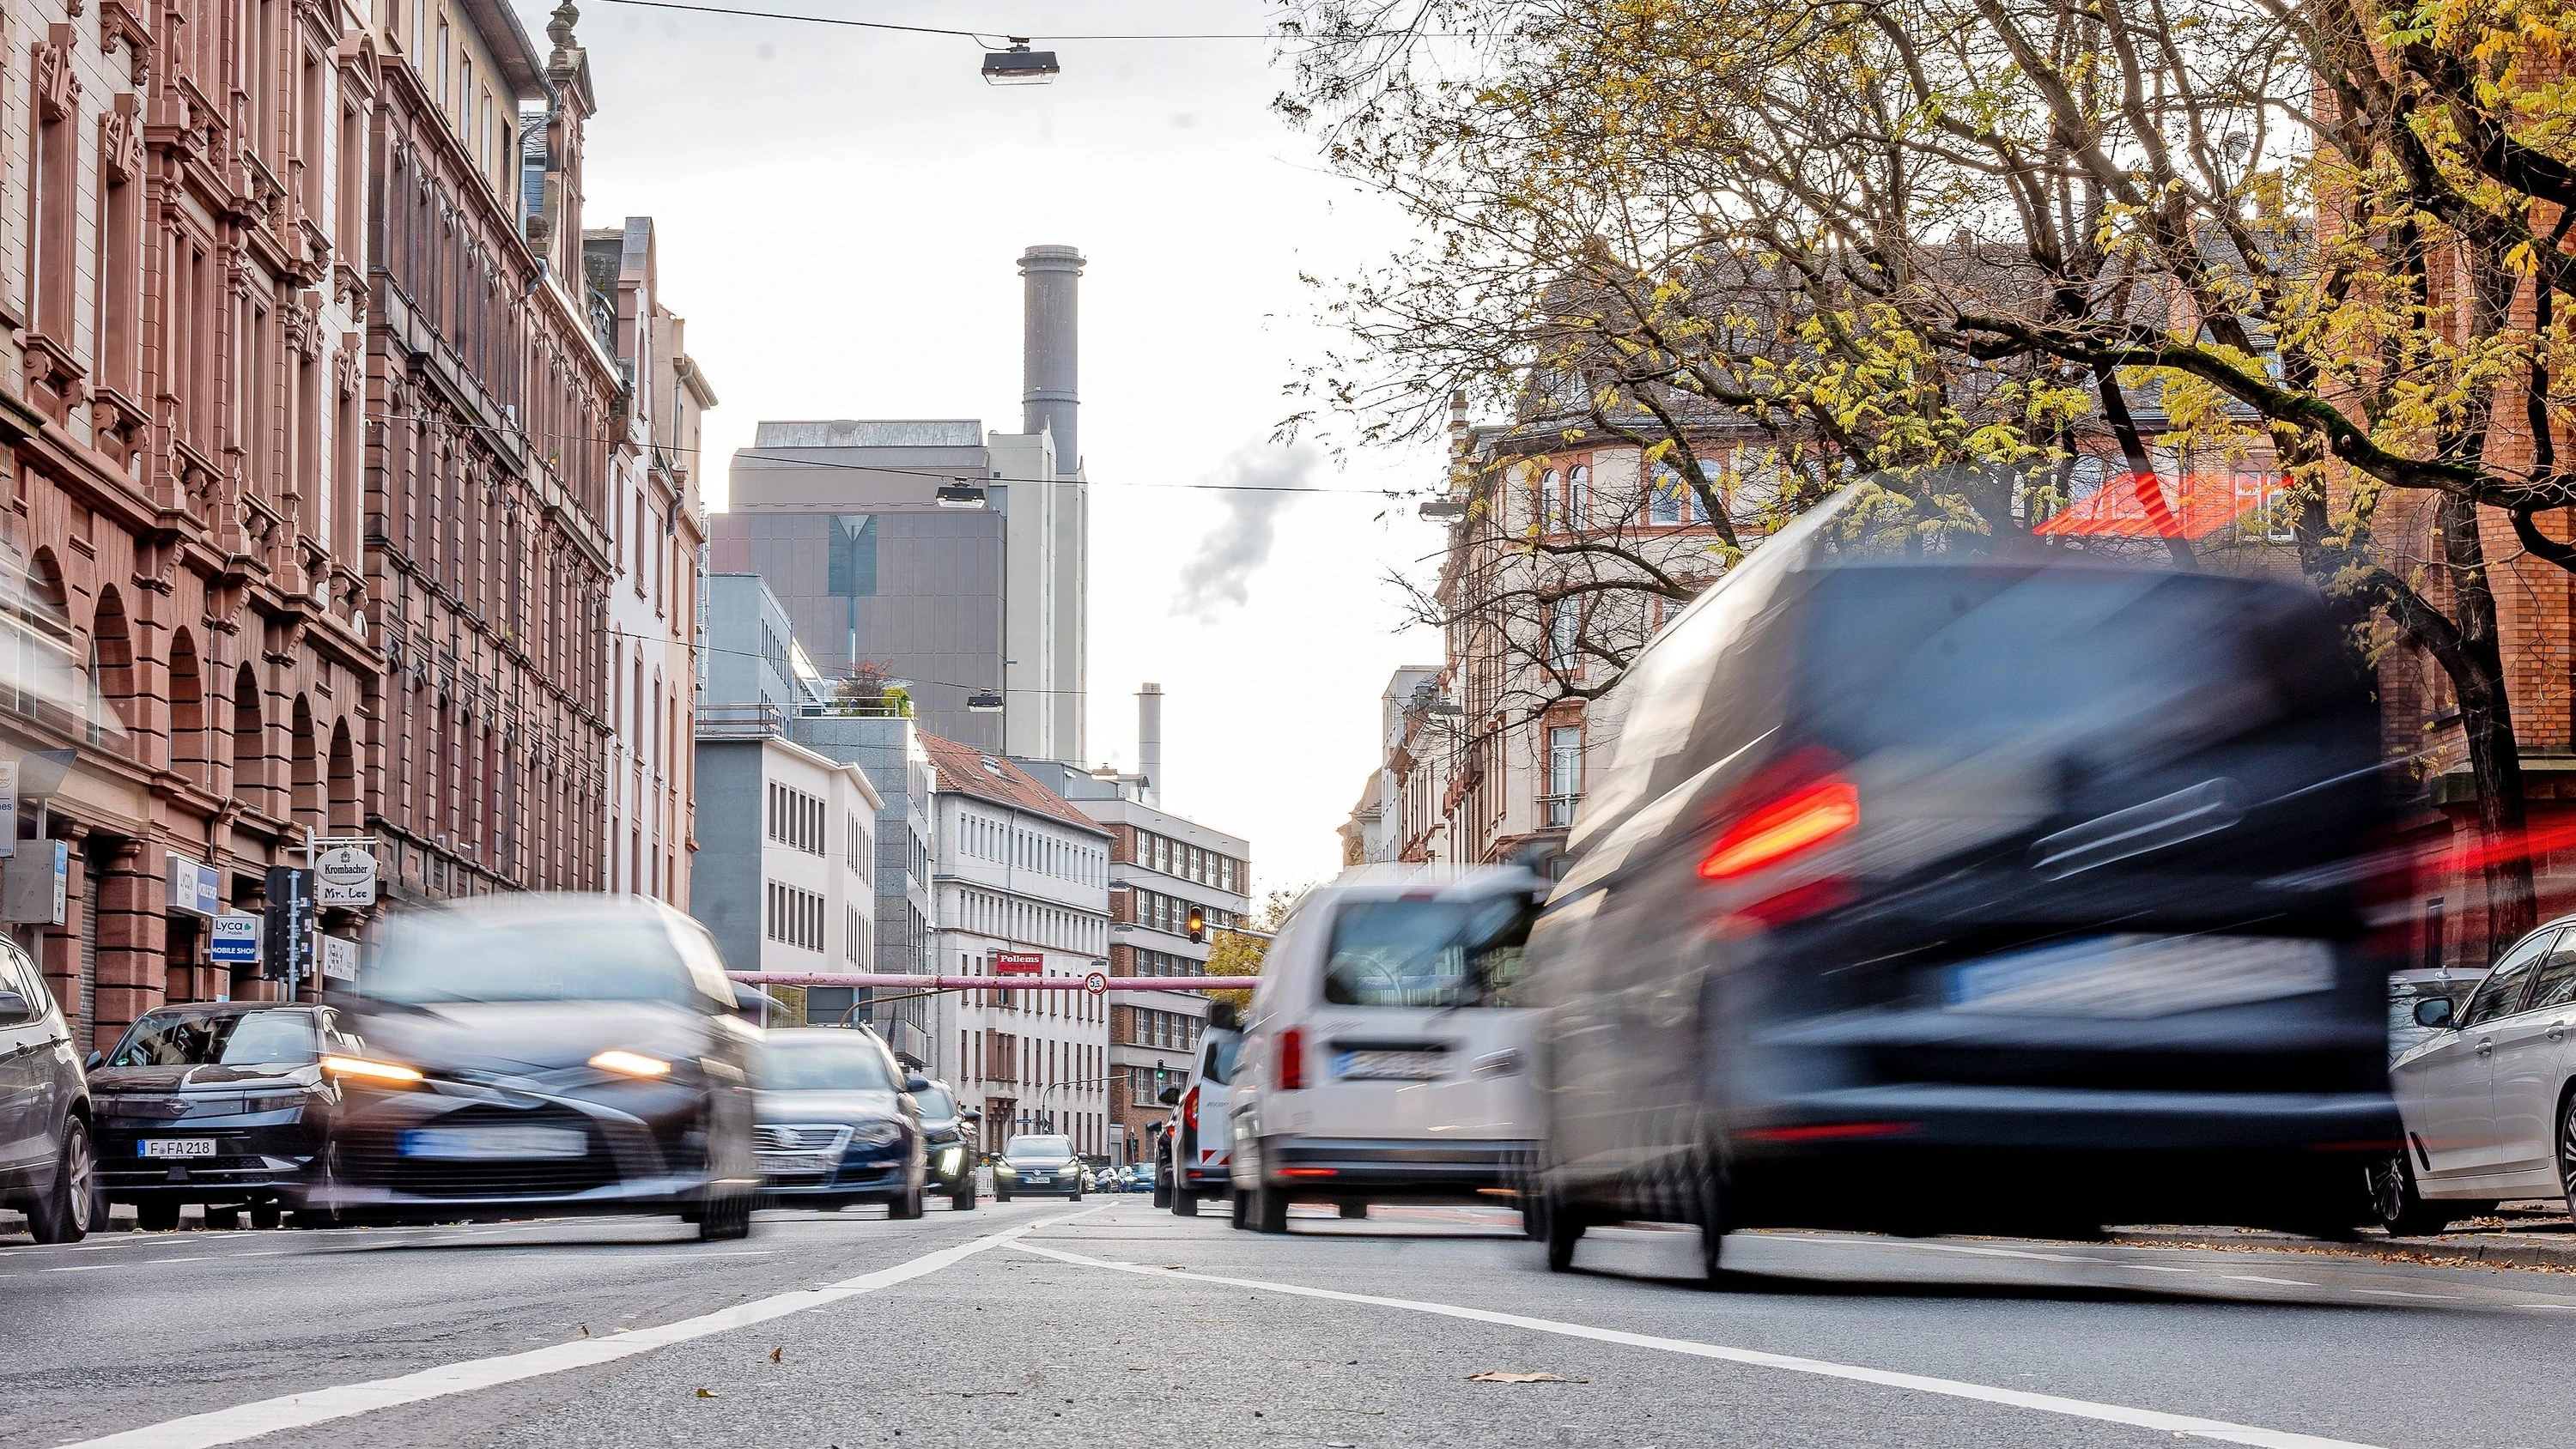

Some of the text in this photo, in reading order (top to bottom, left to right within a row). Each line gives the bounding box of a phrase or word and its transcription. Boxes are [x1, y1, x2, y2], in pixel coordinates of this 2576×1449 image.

[325, 864, 368, 874] Krombacher
[324, 888, 368, 900] Mr. Lee
[216, 920, 243, 931] Lyca
